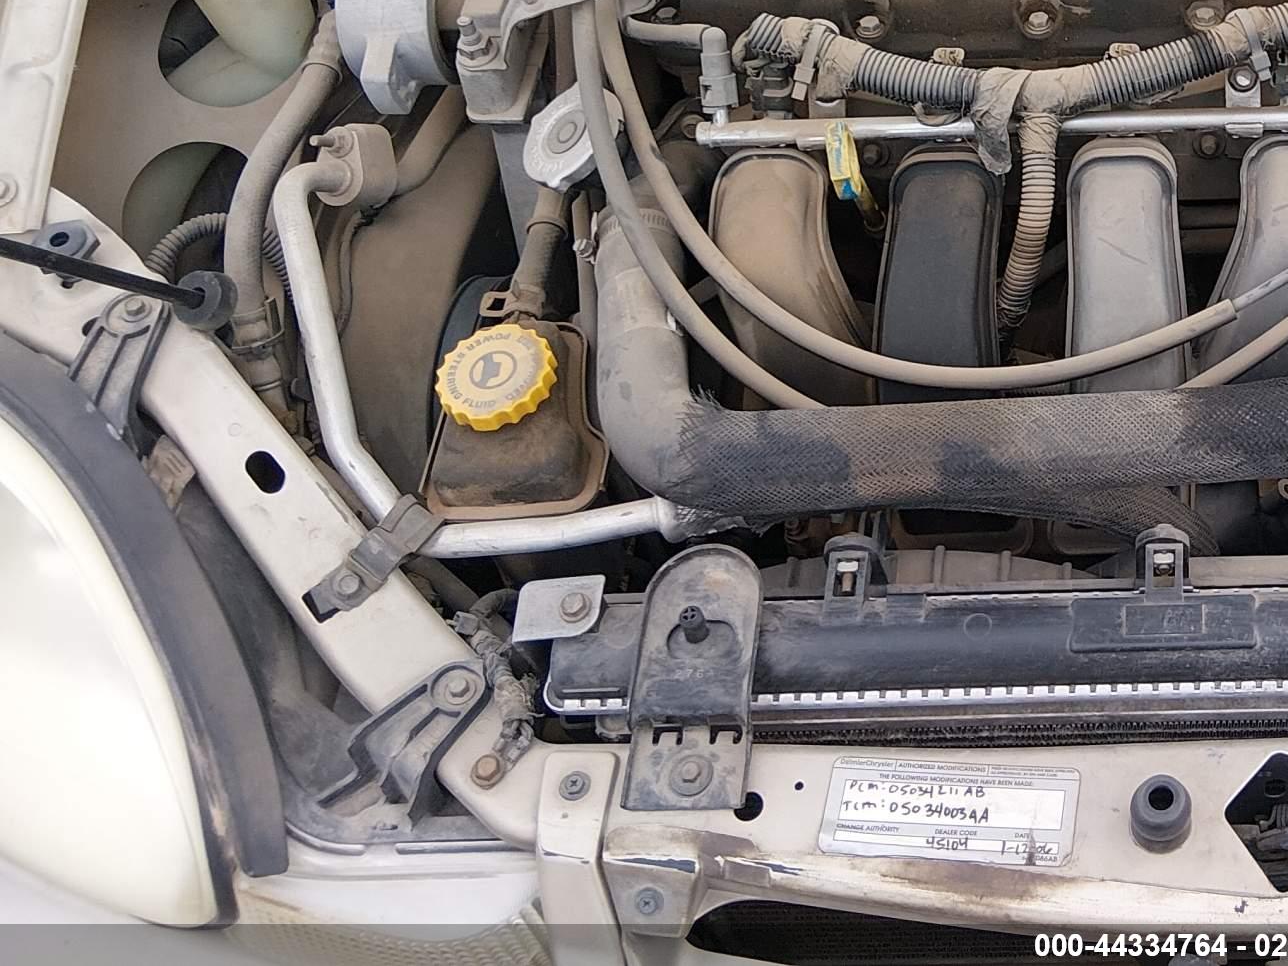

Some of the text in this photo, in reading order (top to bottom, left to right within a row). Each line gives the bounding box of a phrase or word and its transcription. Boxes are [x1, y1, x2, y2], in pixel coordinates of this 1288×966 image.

[447, 332, 512, 409] POWER STEERING FLUID
[841, 758, 894, 768] DaimlerChrysler
[937, 764, 986, 774] MODIFICATIONS
[891, 774, 928, 782] FOLLOWING
[930, 776, 979, 785] MODIFICATIONS
[865, 825, 900, 833] AUTHORITY
[926, 837, 969, 851] 45104
